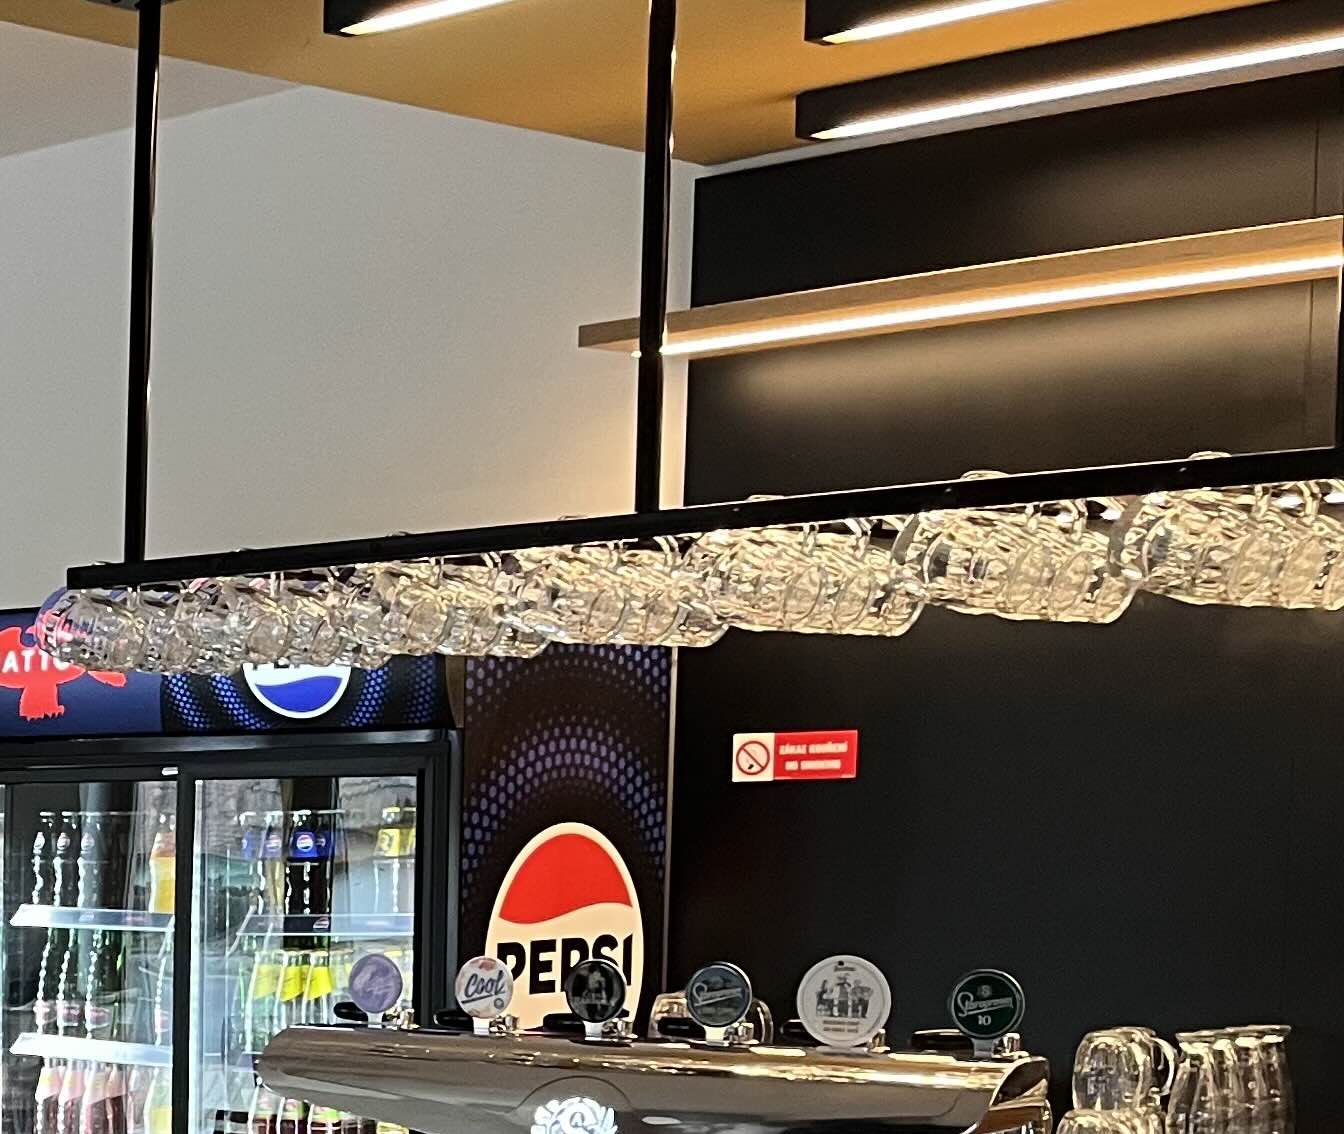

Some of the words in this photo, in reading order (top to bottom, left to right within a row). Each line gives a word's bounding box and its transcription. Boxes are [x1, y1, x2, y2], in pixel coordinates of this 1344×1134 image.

[496, 933, 634, 996] PEPSI
[464, 969, 506, 998] Cool
[977, 1015, 992, 1026] 10
